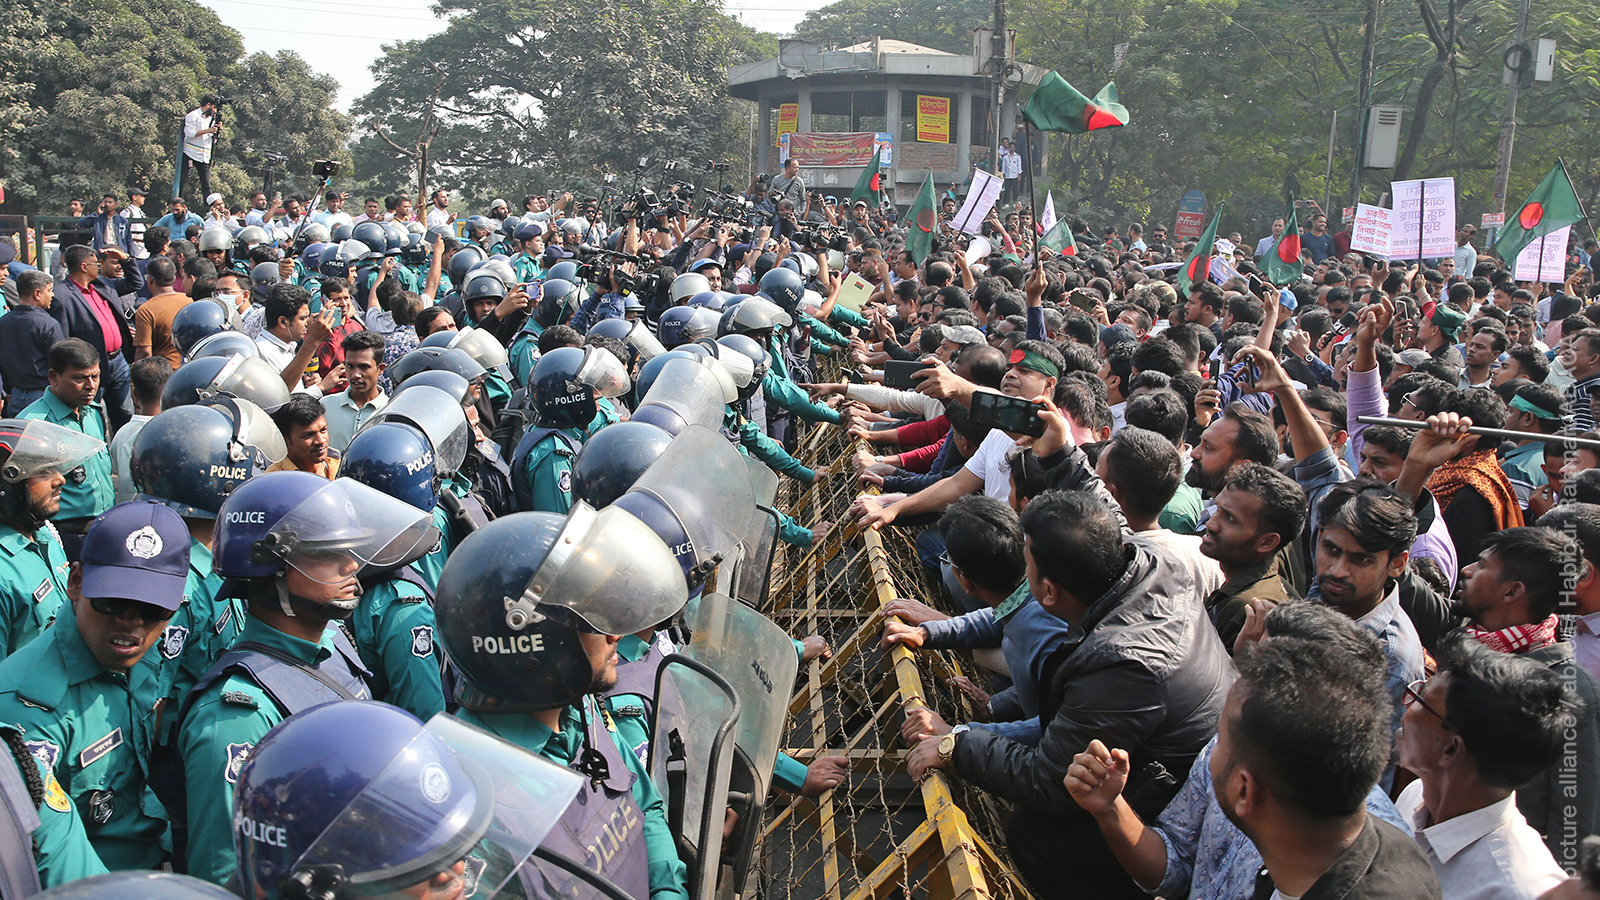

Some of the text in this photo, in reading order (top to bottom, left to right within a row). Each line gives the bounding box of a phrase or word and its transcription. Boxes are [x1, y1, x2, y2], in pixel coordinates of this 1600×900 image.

[1183, 216, 1201, 227] Fresh
[784, 287, 798, 301] POLICE
[554, 392, 586, 406] POLICE
[406, 450, 433, 476] POLICE
[209, 464, 247, 480] POLICE
[225, 511, 266, 524] POLICE
[670, 541, 692, 557] LICE
[472, 633, 545, 654] POLICE
